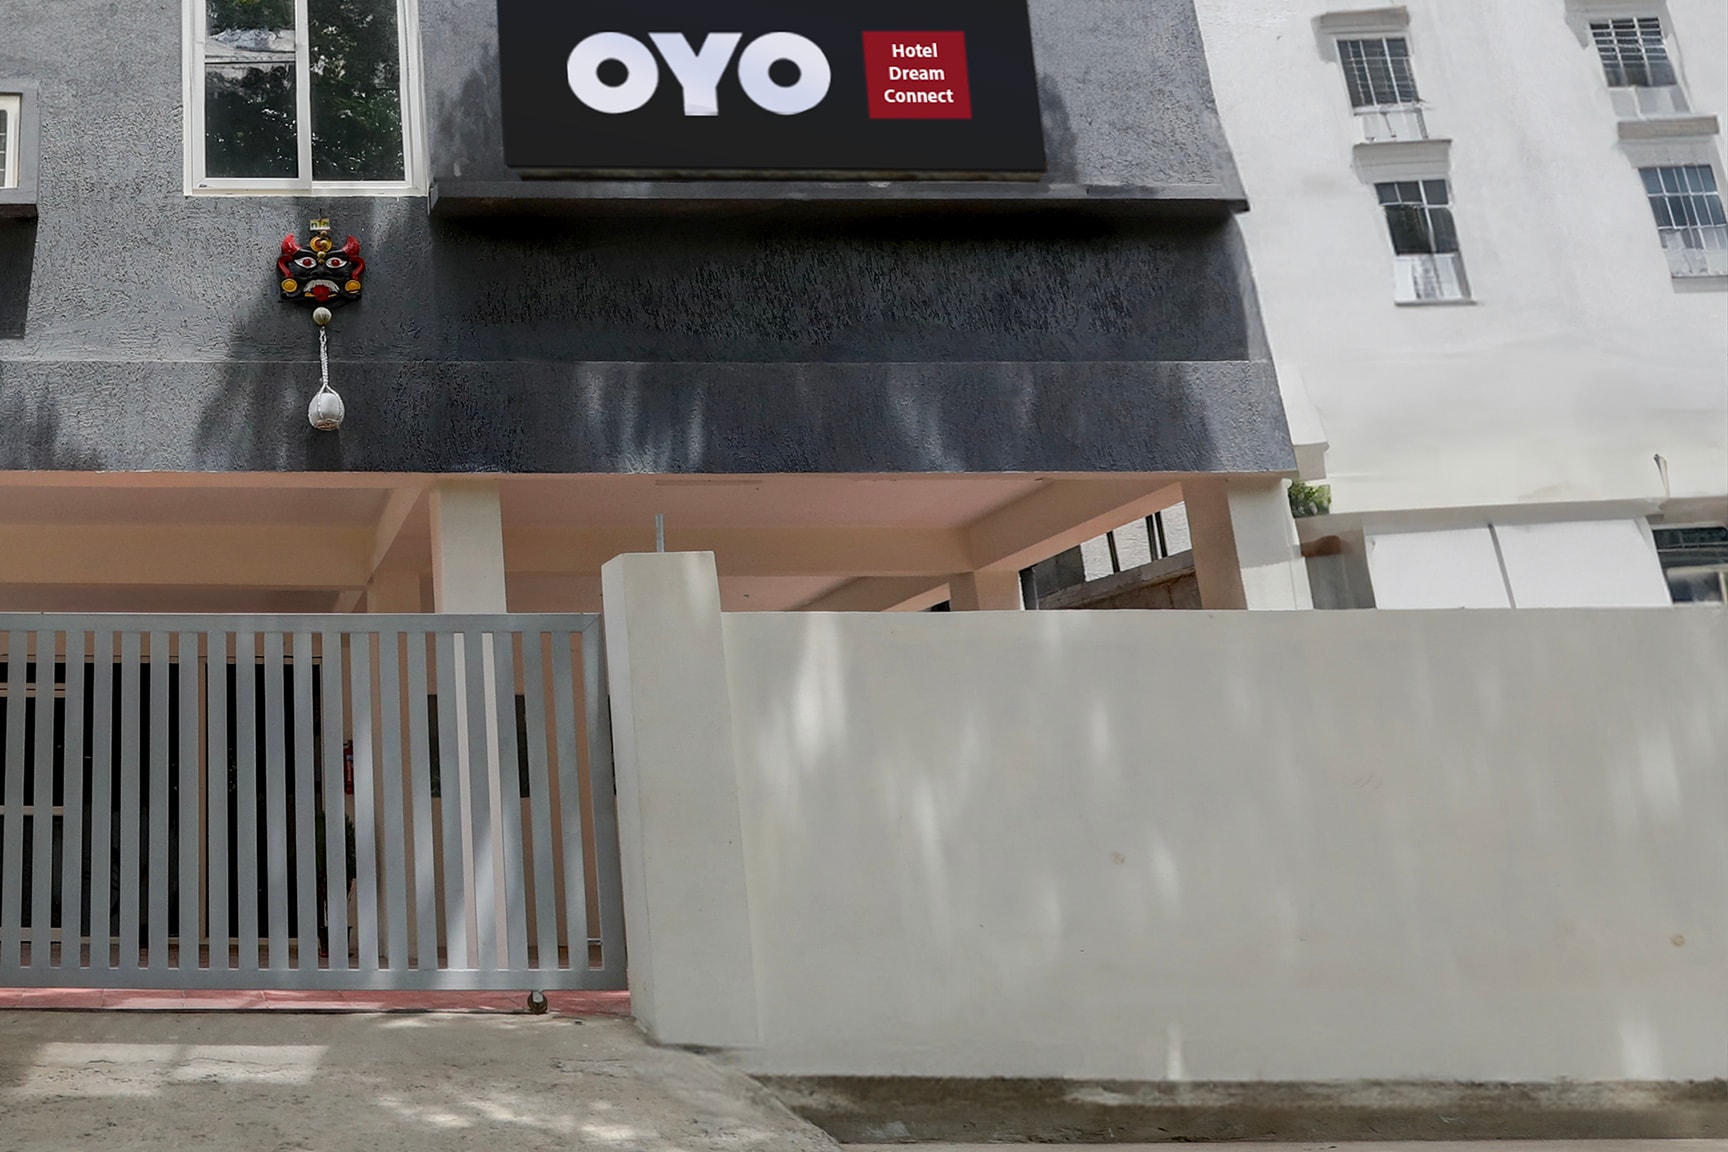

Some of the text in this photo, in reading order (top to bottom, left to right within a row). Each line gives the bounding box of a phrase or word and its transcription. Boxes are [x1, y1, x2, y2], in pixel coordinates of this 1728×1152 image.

[891, 42, 939, 58] Hotel
[567, 31, 831, 116] OYO
[888, 66, 945, 81] Dream
[883, 89, 955, 103] Connect
